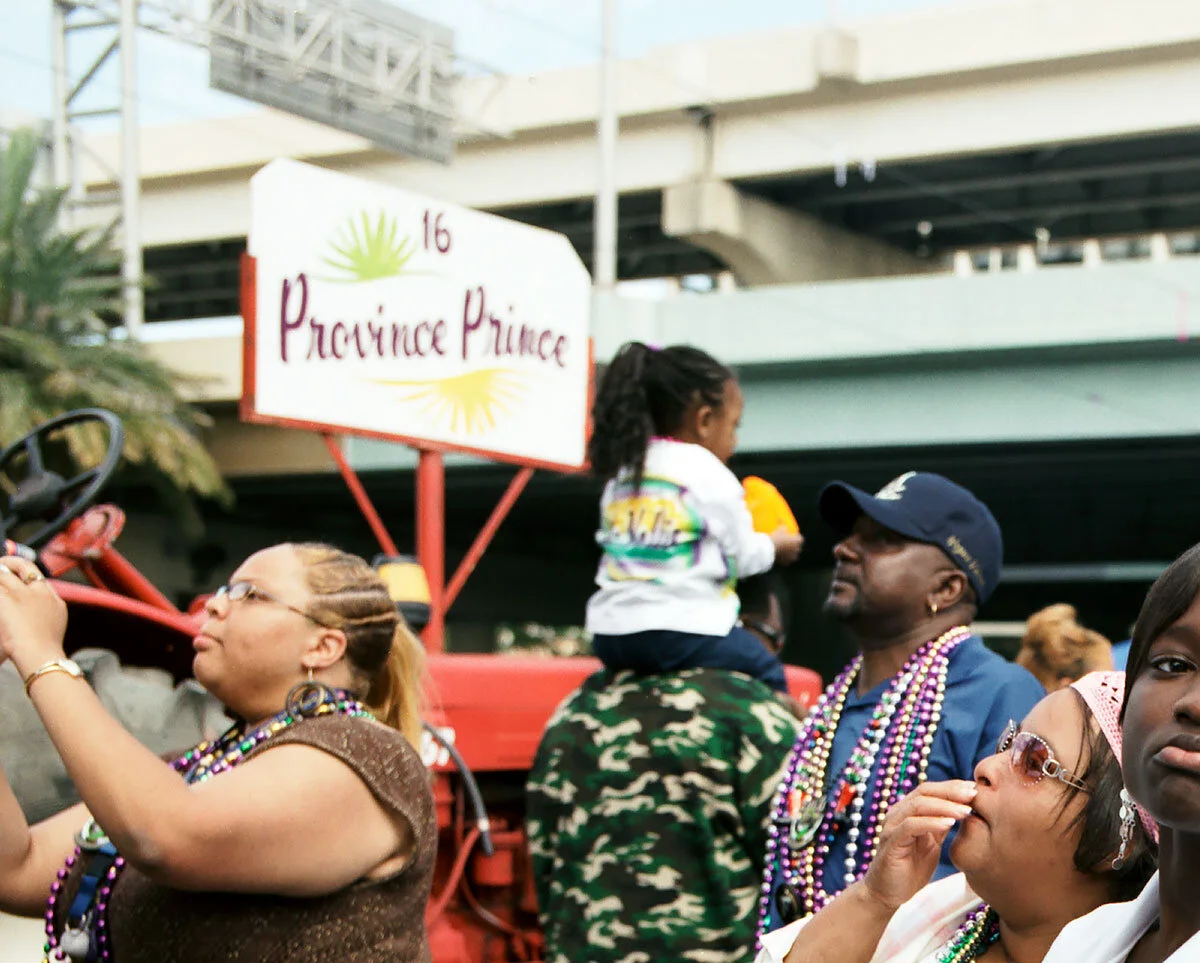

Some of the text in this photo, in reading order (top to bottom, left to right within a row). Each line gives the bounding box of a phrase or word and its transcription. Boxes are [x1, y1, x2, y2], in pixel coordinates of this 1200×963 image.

[422, 208, 452, 254] 16
[279, 272, 570, 368] Province Prince
